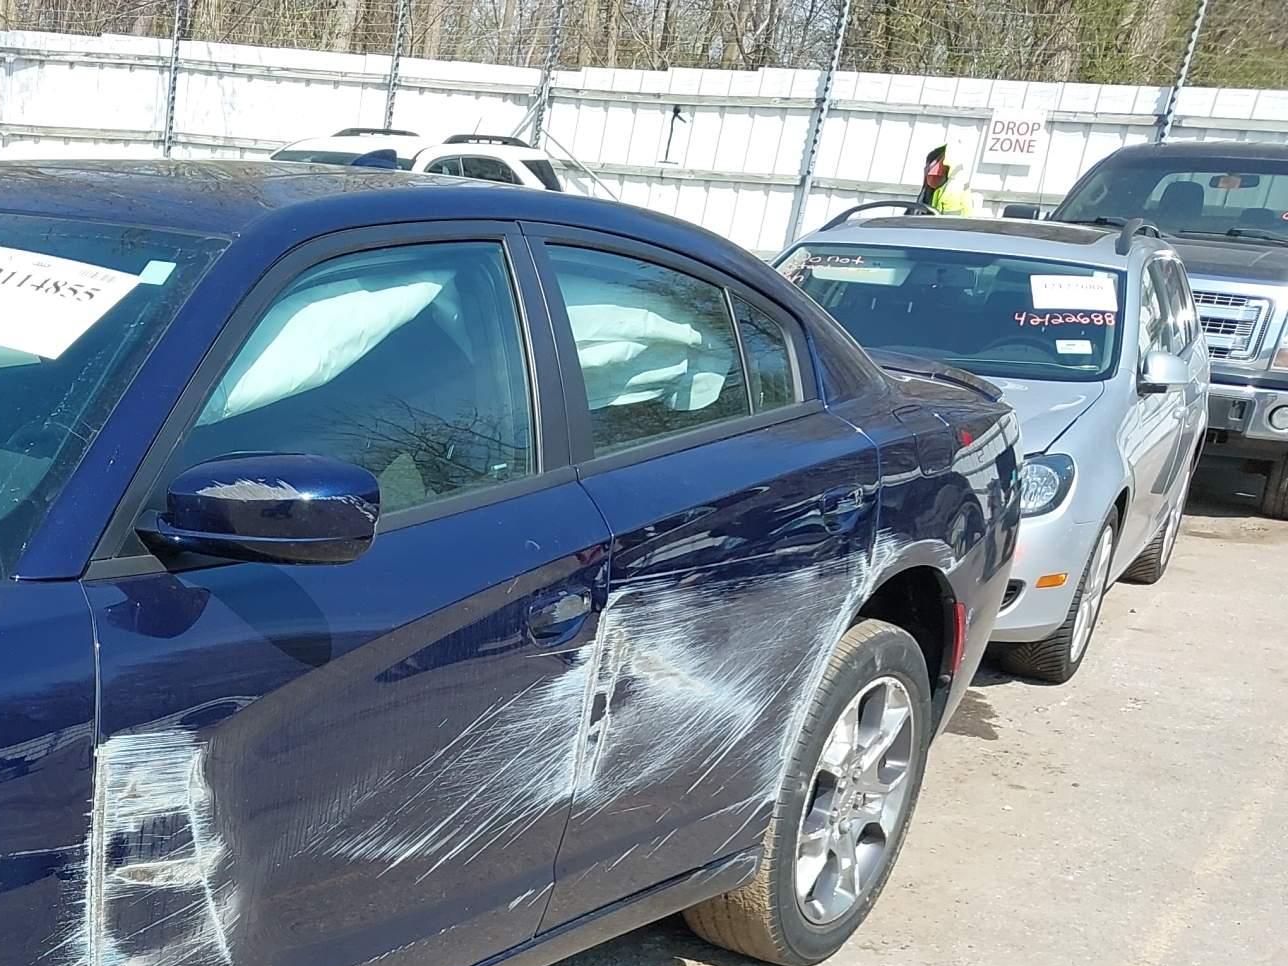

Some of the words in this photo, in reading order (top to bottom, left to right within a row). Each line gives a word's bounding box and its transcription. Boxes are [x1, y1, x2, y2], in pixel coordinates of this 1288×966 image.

[992, 120, 1041, 136] DROP
[988, 137, 1038, 153] ZONE
[1014, 312, 1116, 326] 42122688
